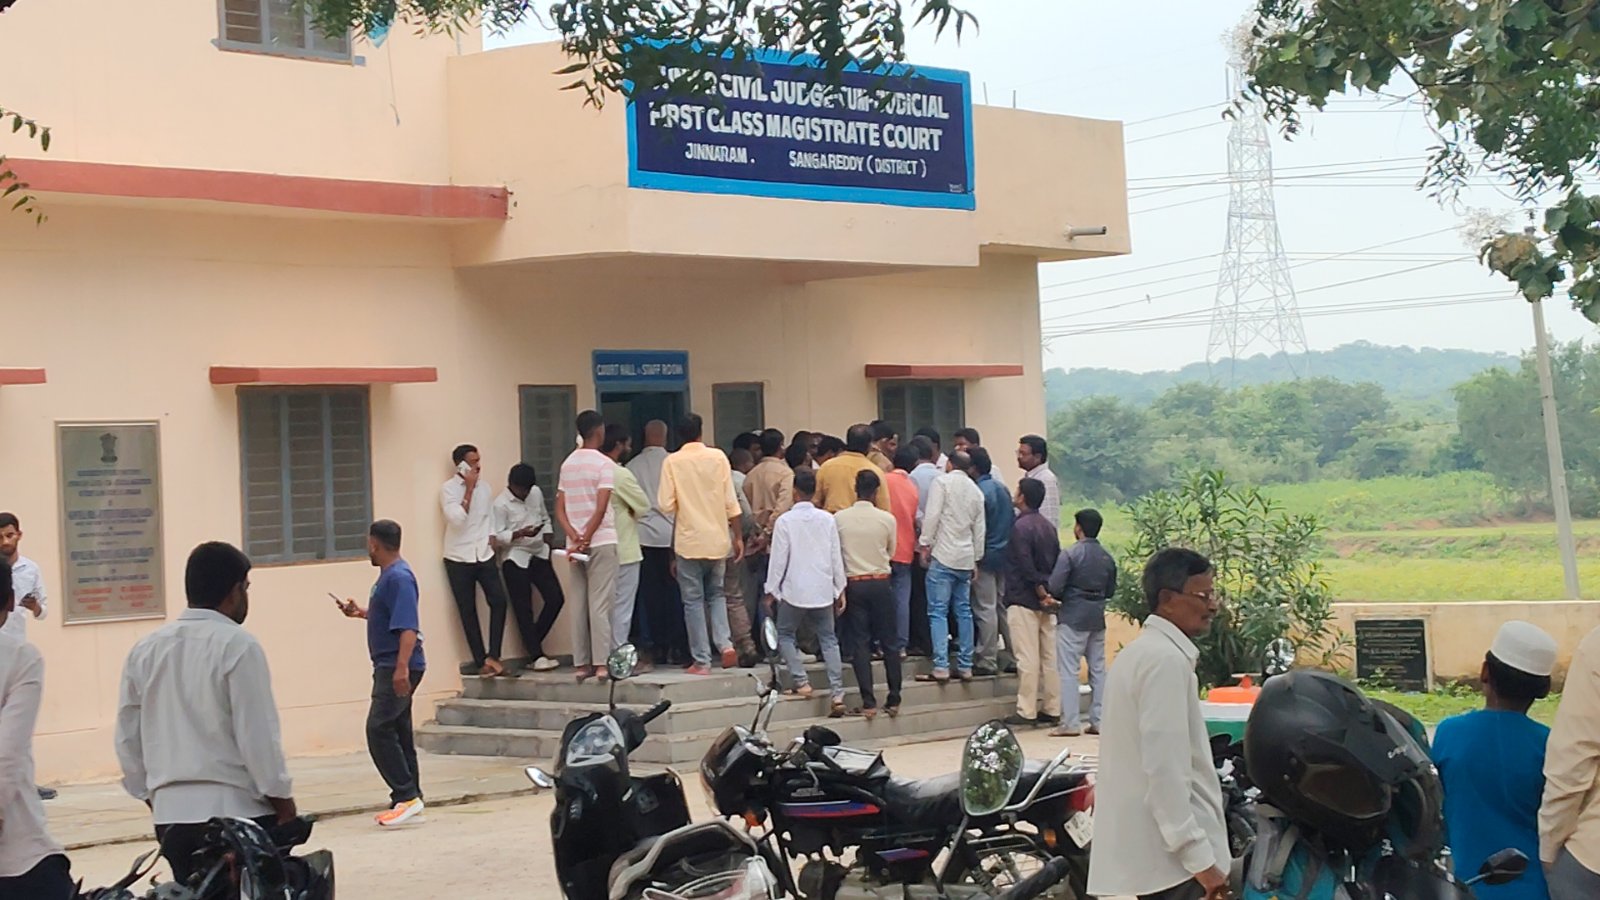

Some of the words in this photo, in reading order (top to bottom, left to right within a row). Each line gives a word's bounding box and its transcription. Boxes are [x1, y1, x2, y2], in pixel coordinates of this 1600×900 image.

[719, 73, 769, 102] CIVIL
[706, 107, 765, 137] CLASS
[766, 114, 881, 147] MAGISTRATE
[883, 123, 943, 151] COURT
[789, 150, 865, 173] SANGAREDDY
